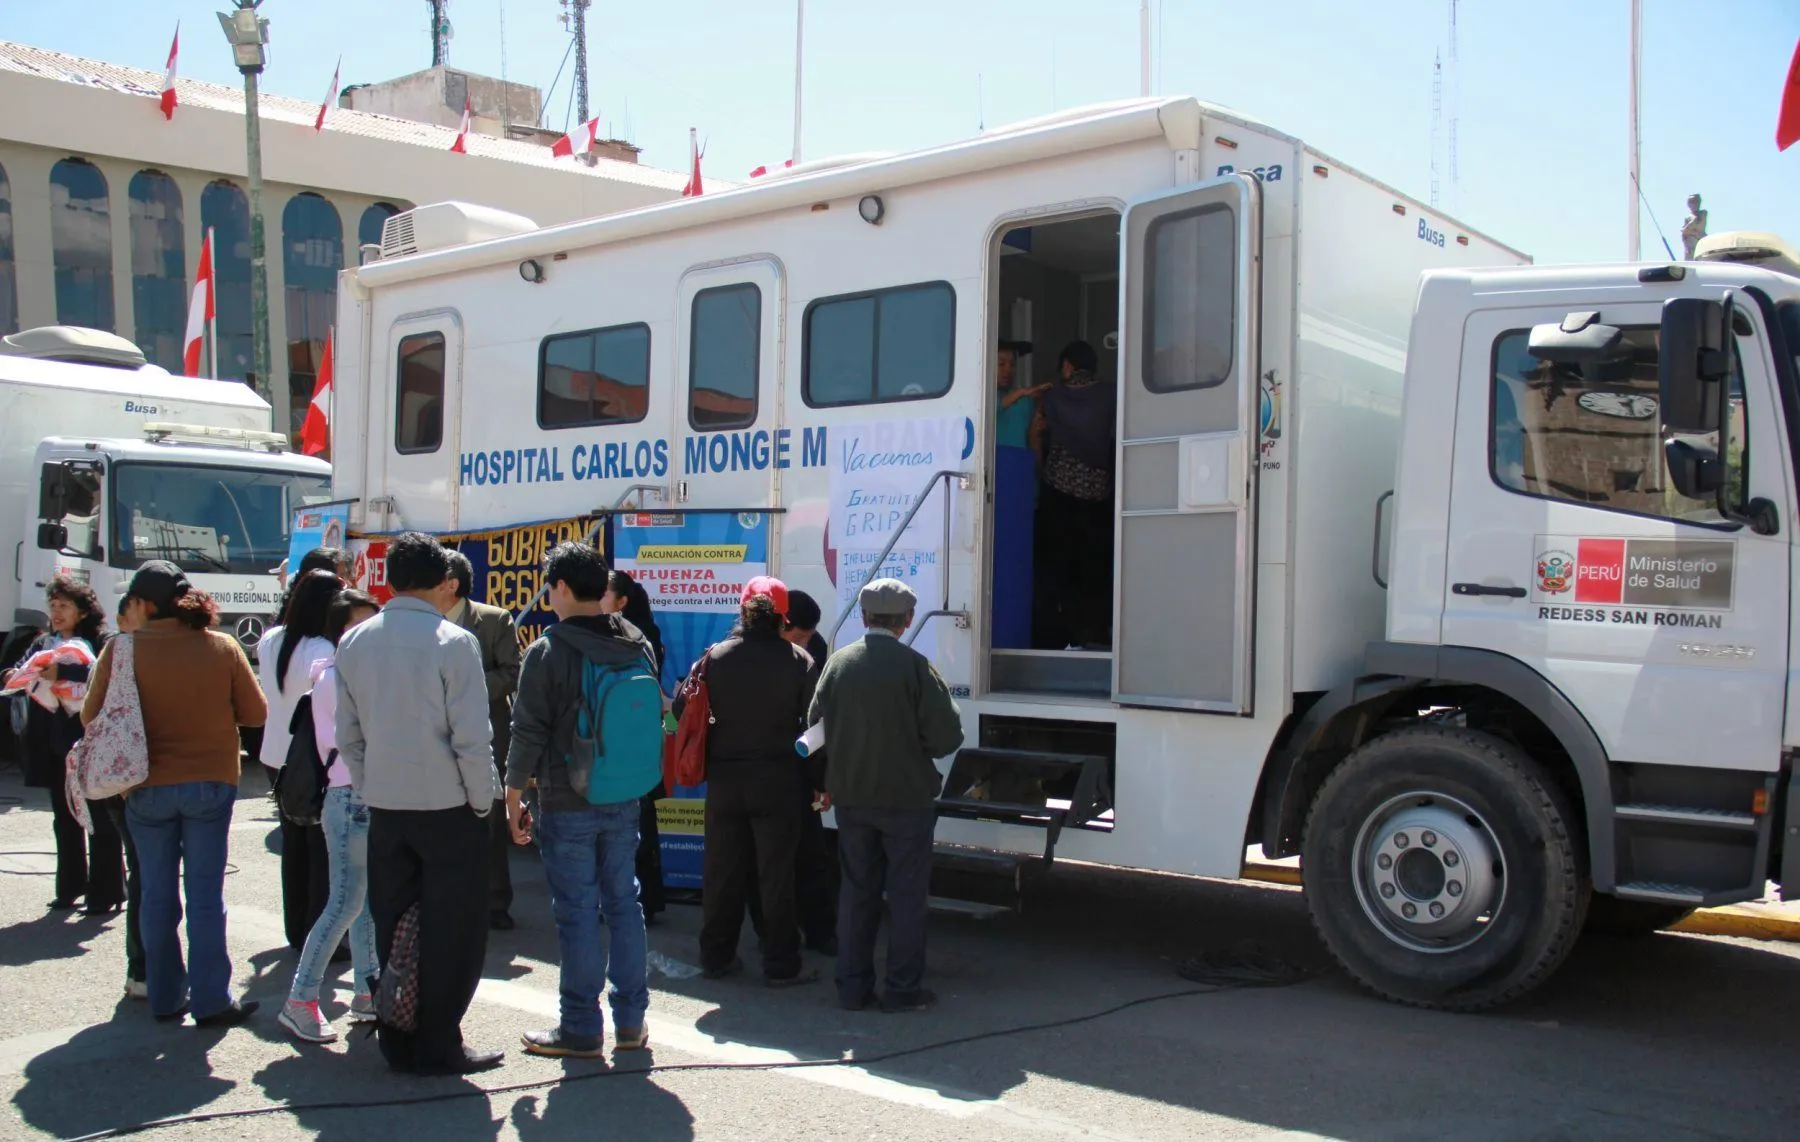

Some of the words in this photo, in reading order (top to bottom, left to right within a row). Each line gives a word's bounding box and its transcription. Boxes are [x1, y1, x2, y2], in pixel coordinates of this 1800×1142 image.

[1216, 164, 1283, 183] Bsa
[1416, 217, 1446, 248] Busa
[124, 401, 157, 415] Busa
[460, 446, 564, 486] HOSPITAL
[571, 438, 669, 481] CARLOS
[684, 429, 792, 475] MONGE
[843, 437, 934, 474] Vacunas
[1263, 461, 1281, 470] PUNO
[641, 548, 702, 560] VACUNACIÓN
[704, 549, 742, 559] CONTRA
[843, 551, 908, 566] INFLUEZA
[1577, 563, 1621, 581] PERÚ
[1629, 555, 1718, 574] Ministerio
[622, 568, 716, 580] NFLUENZA
[845, 566, 904, 585] HEPAITIS
[1628, 573, 1651, 588] de
[1653, 574, 1701, 591] Salud
[233, 592, 272, 604] REGIONAL
[673, 597, 703, 605] contra
[704, 596, 713, 605] el
[1538, 606, 1606, 623] REDESS
[1611, 610, 1649, 626] SAN
[1654, 612, 1723, 629] ROMAN
